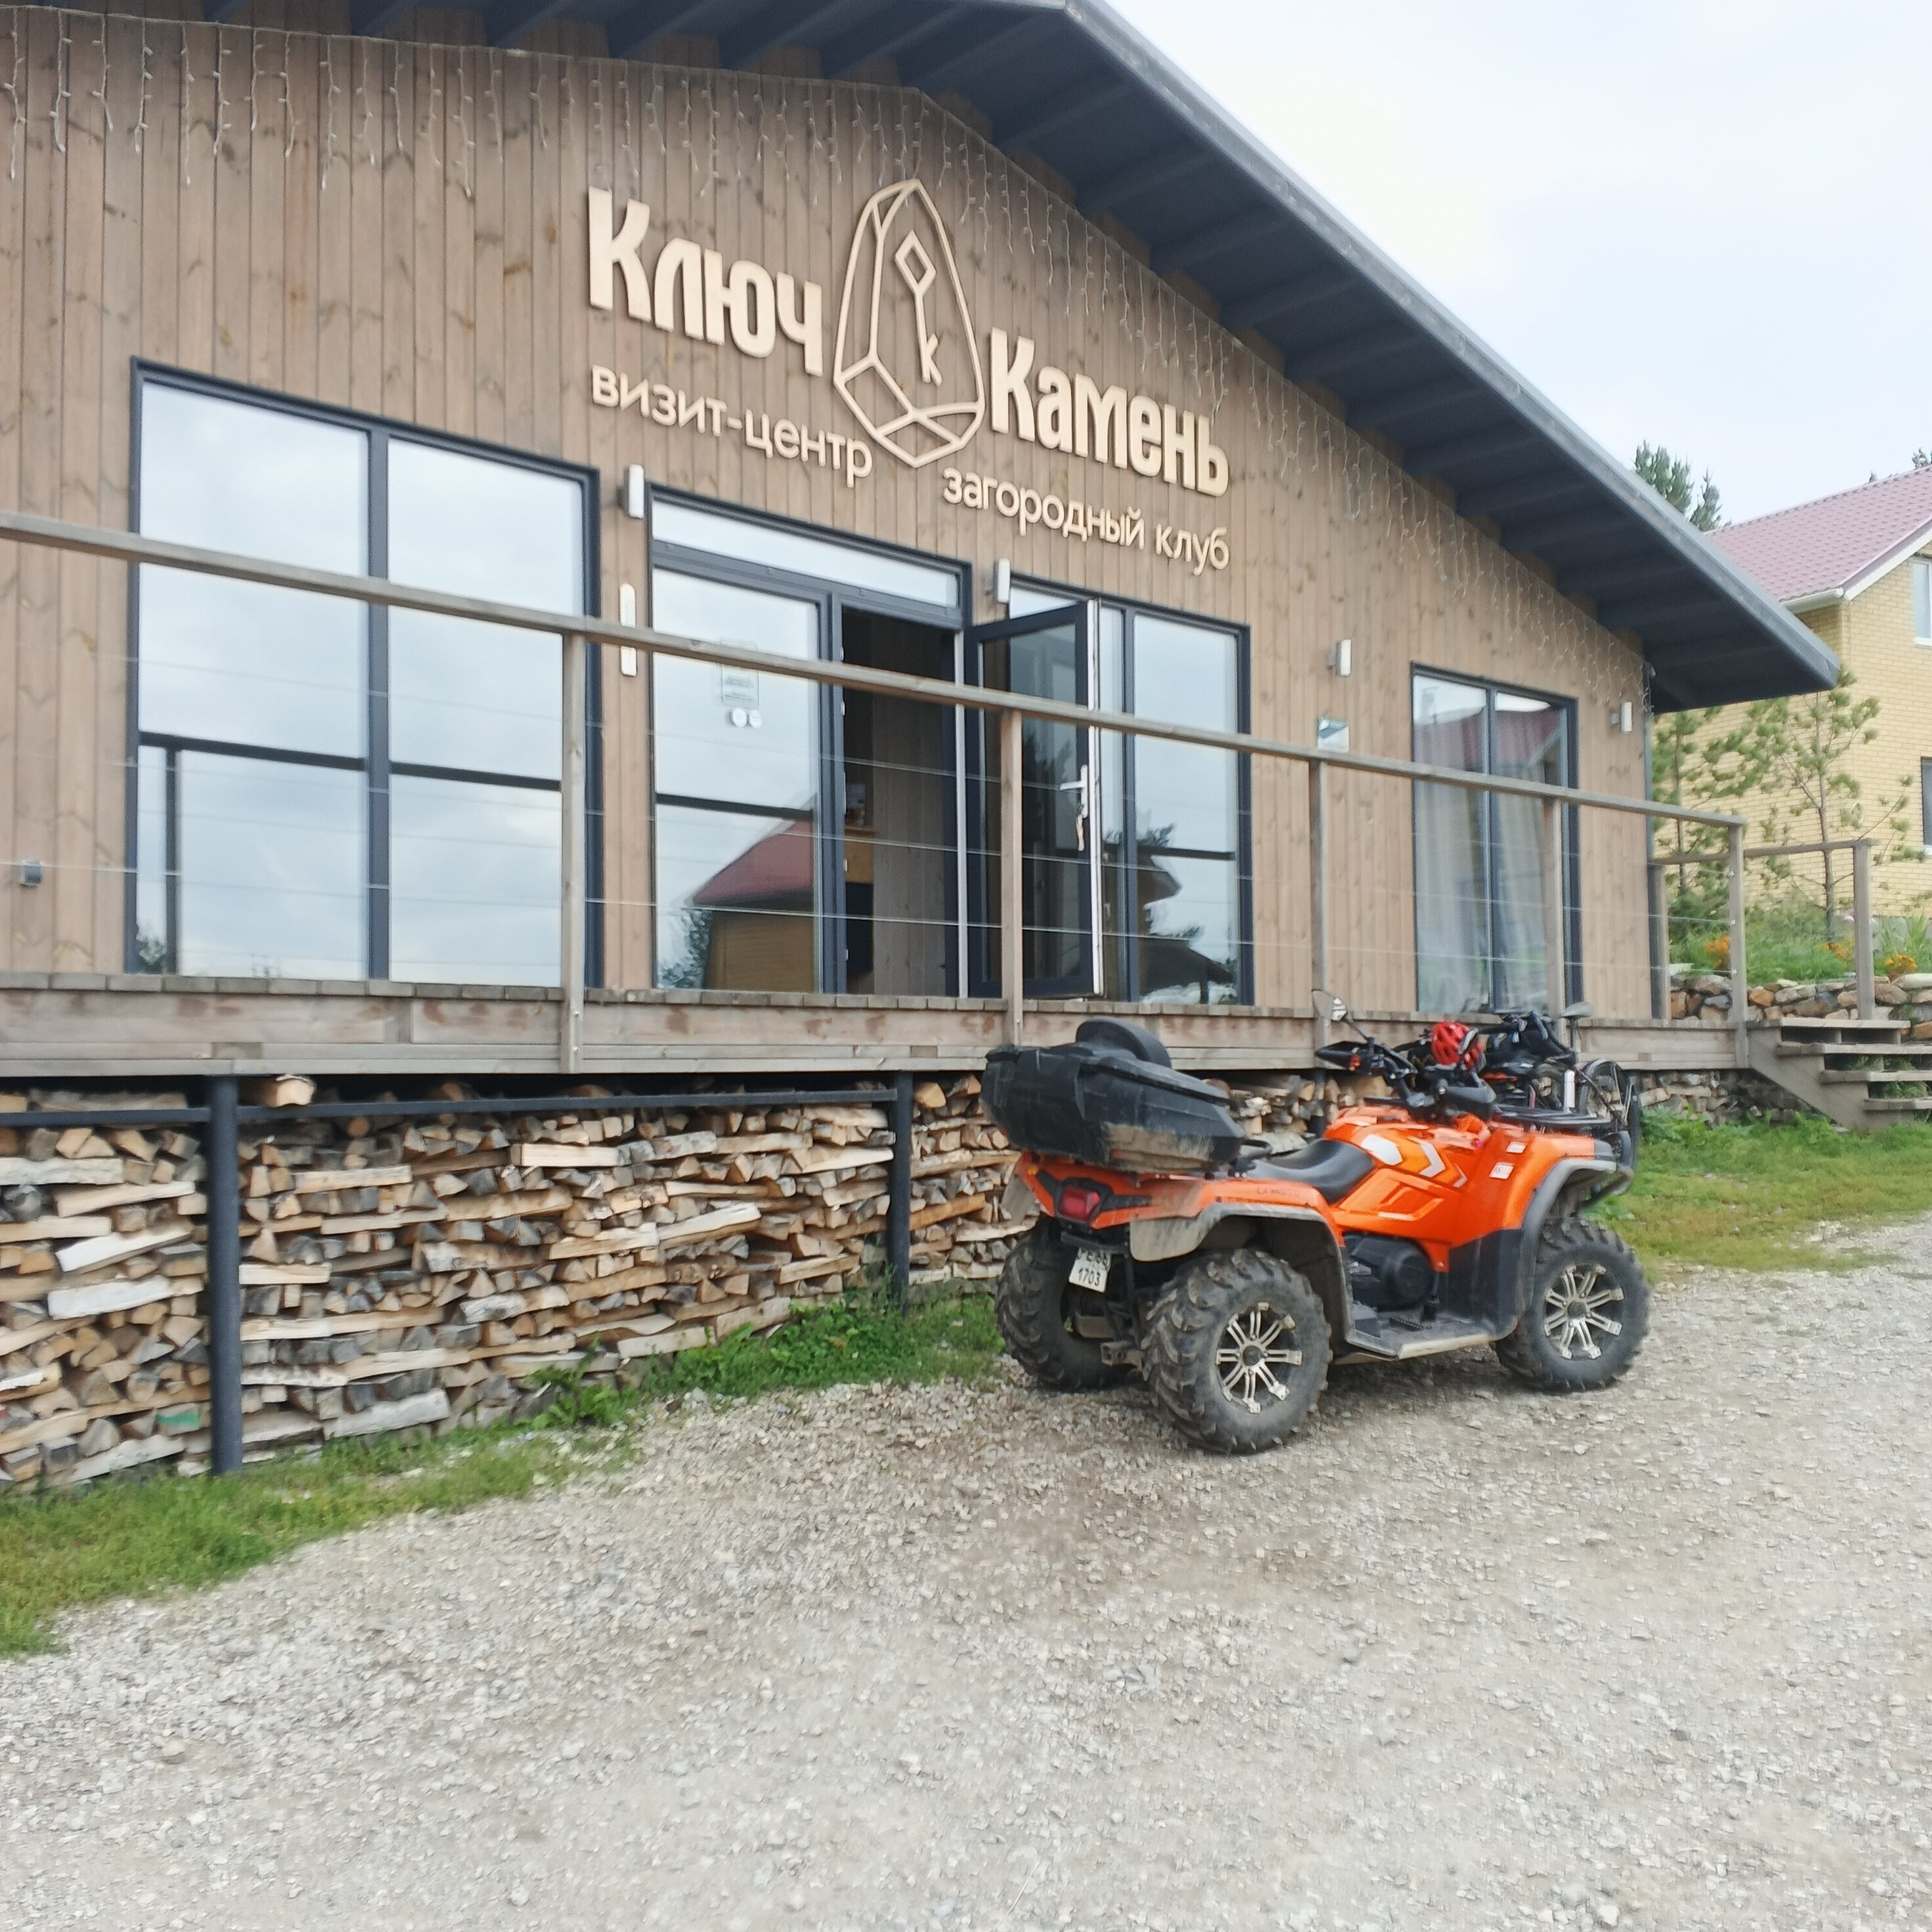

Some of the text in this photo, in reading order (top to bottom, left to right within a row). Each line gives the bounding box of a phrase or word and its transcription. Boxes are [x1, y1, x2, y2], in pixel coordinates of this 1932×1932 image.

[589, 187, 1229, 497] Ключ Камень
[592, 364, 872, 488] визит-центр
[942, 467, 1230, 576] загородный клуб
[1078, 1267, 1101, 1287] 1703
